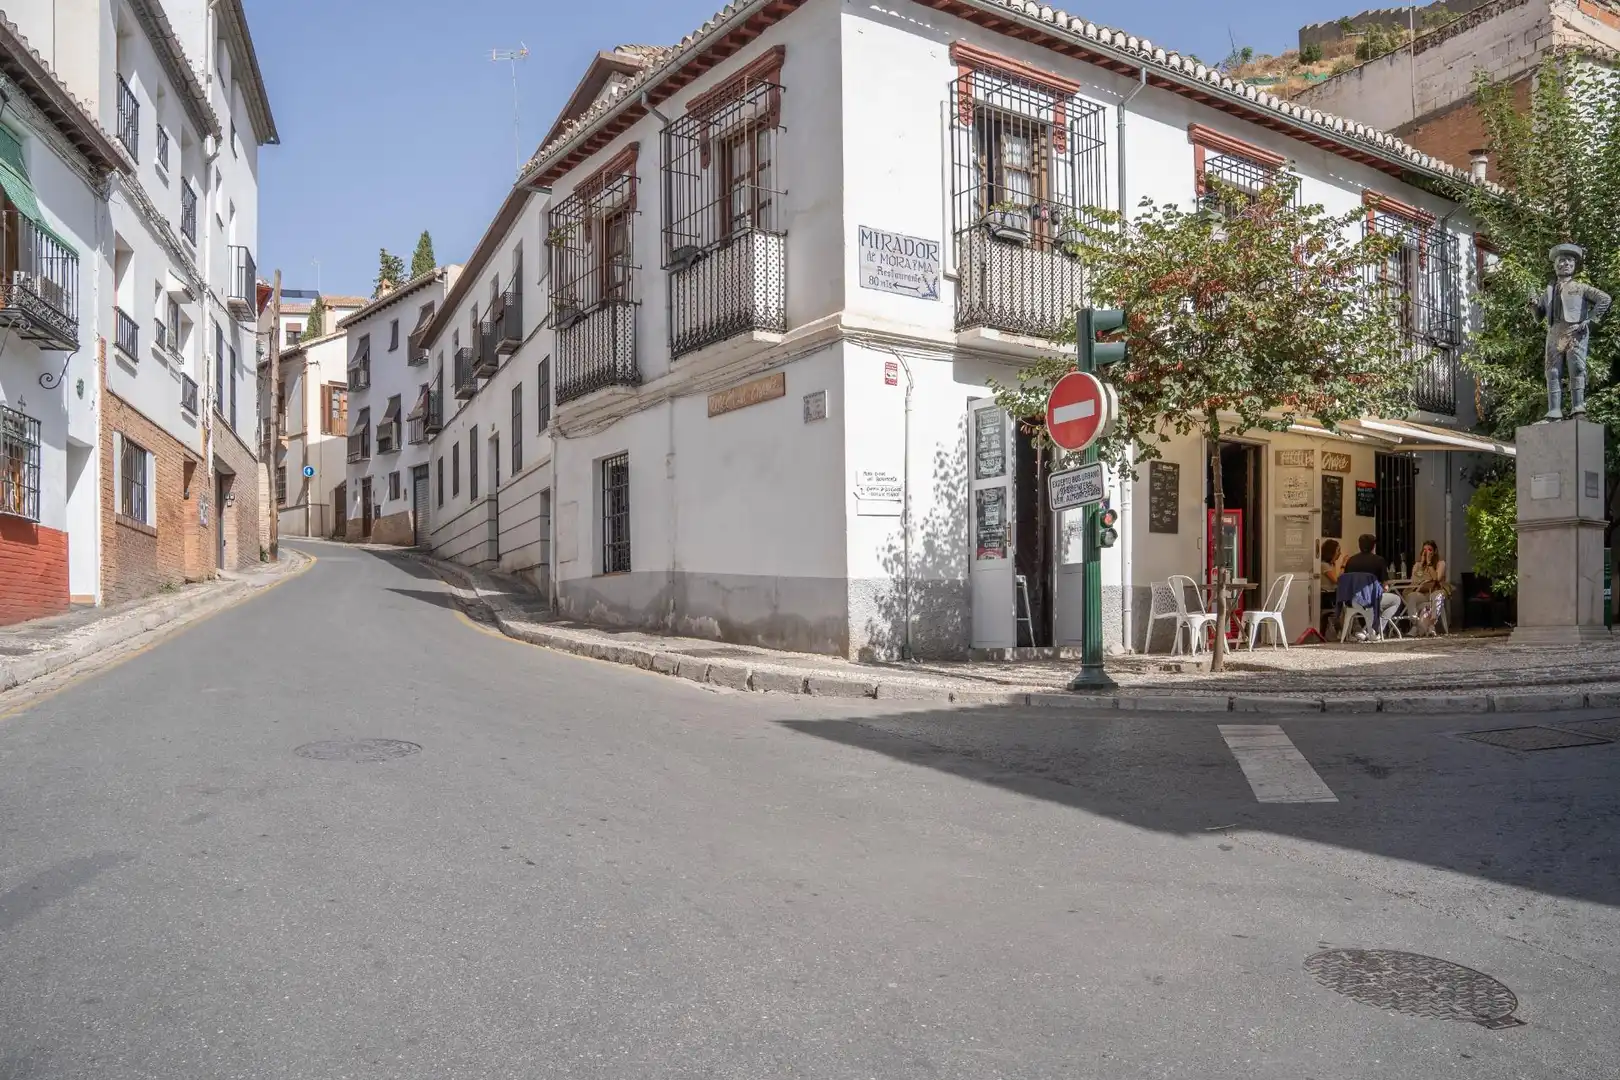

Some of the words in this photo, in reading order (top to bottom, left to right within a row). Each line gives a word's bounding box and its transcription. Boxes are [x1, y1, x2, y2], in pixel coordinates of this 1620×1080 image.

[861, 229, 938, 262] MIRADOR
[868, 275, 879, 286] 80
[876, 266, 922, 283] Restaurante
[1072, 474, 1081, 483] BUS
